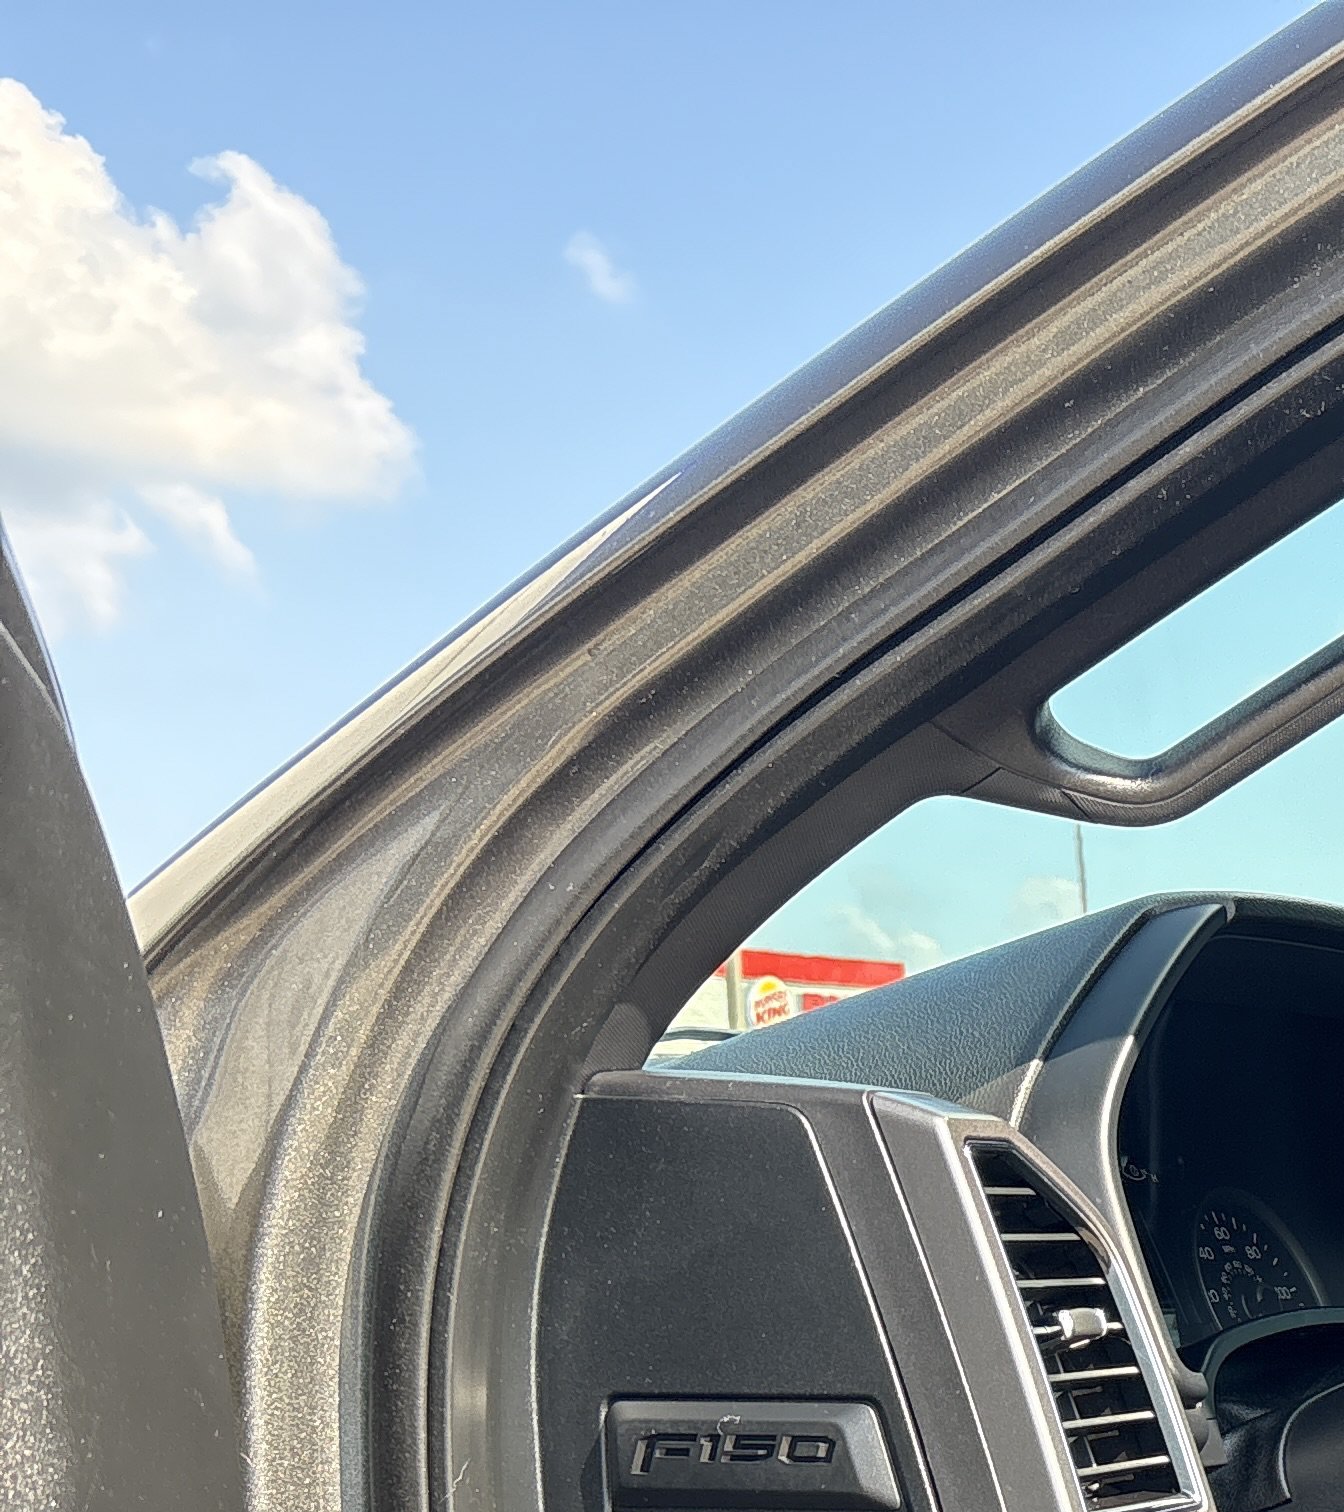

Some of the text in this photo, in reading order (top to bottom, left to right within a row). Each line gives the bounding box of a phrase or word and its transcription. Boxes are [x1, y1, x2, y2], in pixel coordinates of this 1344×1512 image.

[756, 1005, 790, 1024] KING
[1214, 1226, 1230, 1240] 60
[1199, 1246, 1215, 1260] 40
[1245, 1245, 1261, 1259] 80
[630, 1432, 837, 1476] F150
